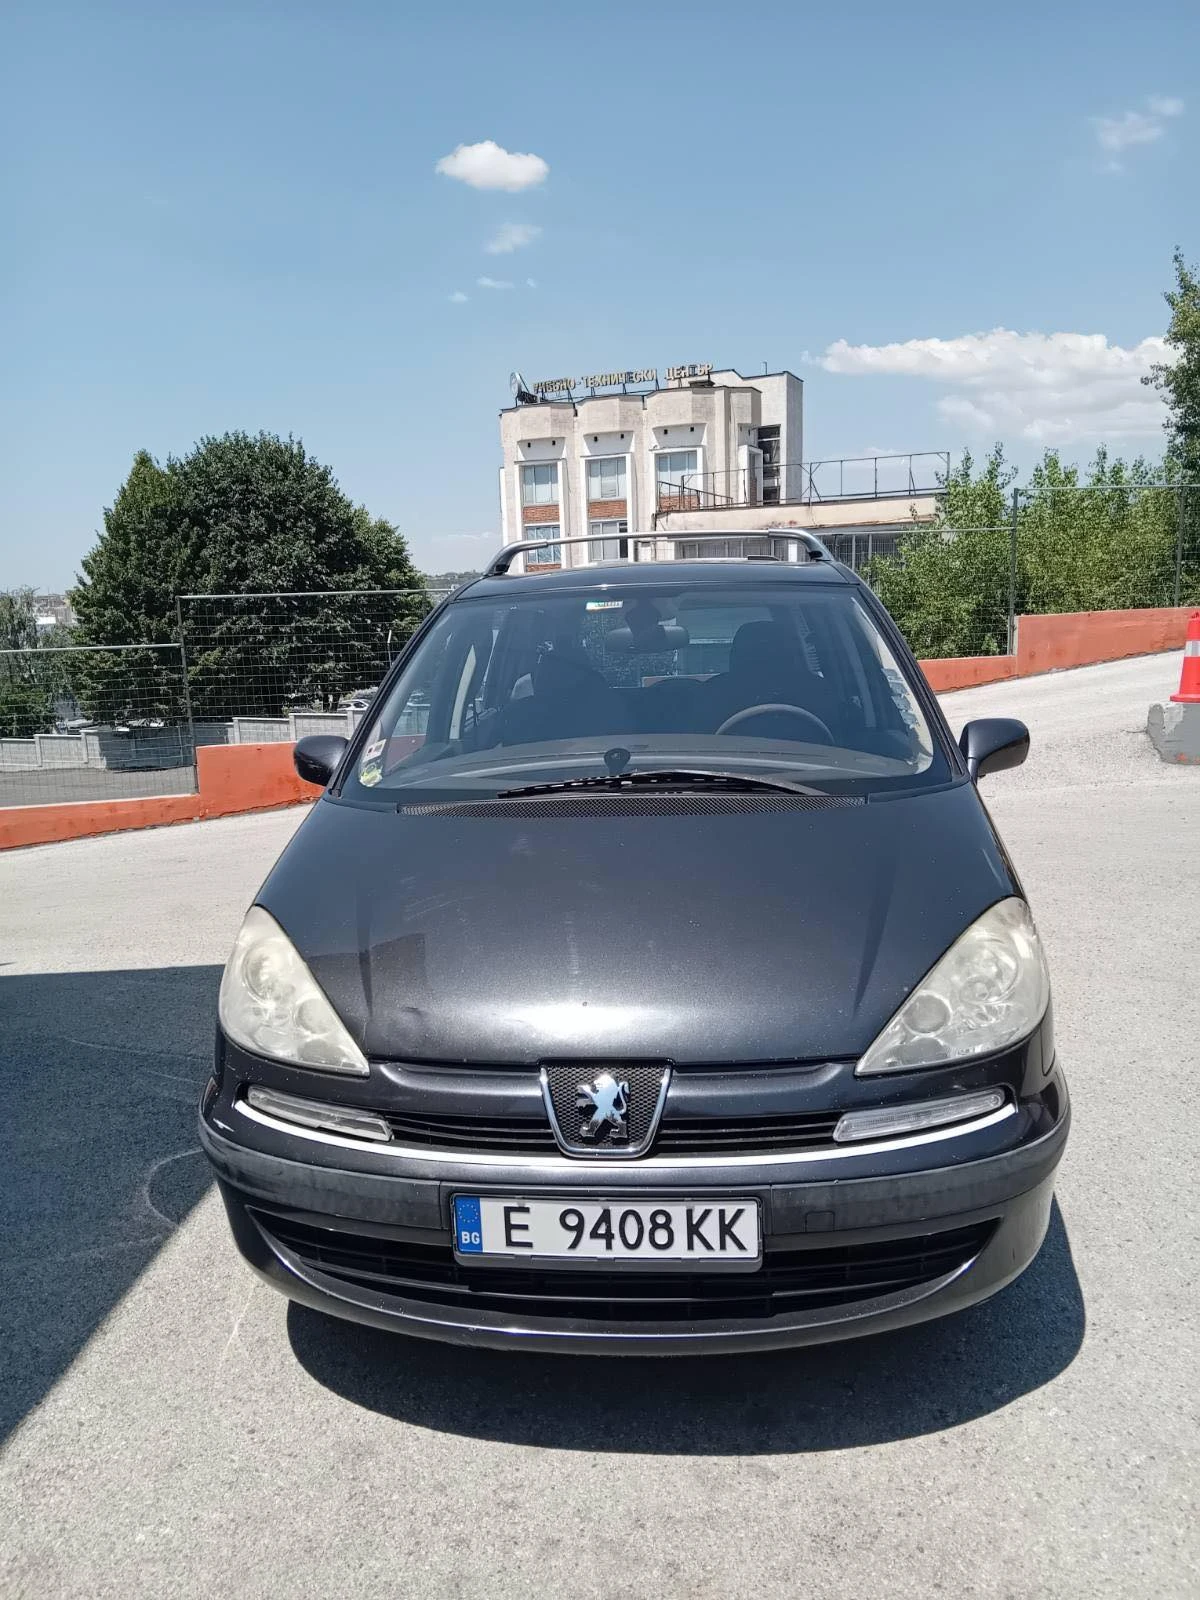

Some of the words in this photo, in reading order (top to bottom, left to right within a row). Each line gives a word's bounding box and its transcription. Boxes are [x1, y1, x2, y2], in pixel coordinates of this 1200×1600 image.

[664, 363, 713, 380] ЦЕНТЪР
[504, 1206, 533, 1248] E
[461, 1231, 480, 1244] BG
